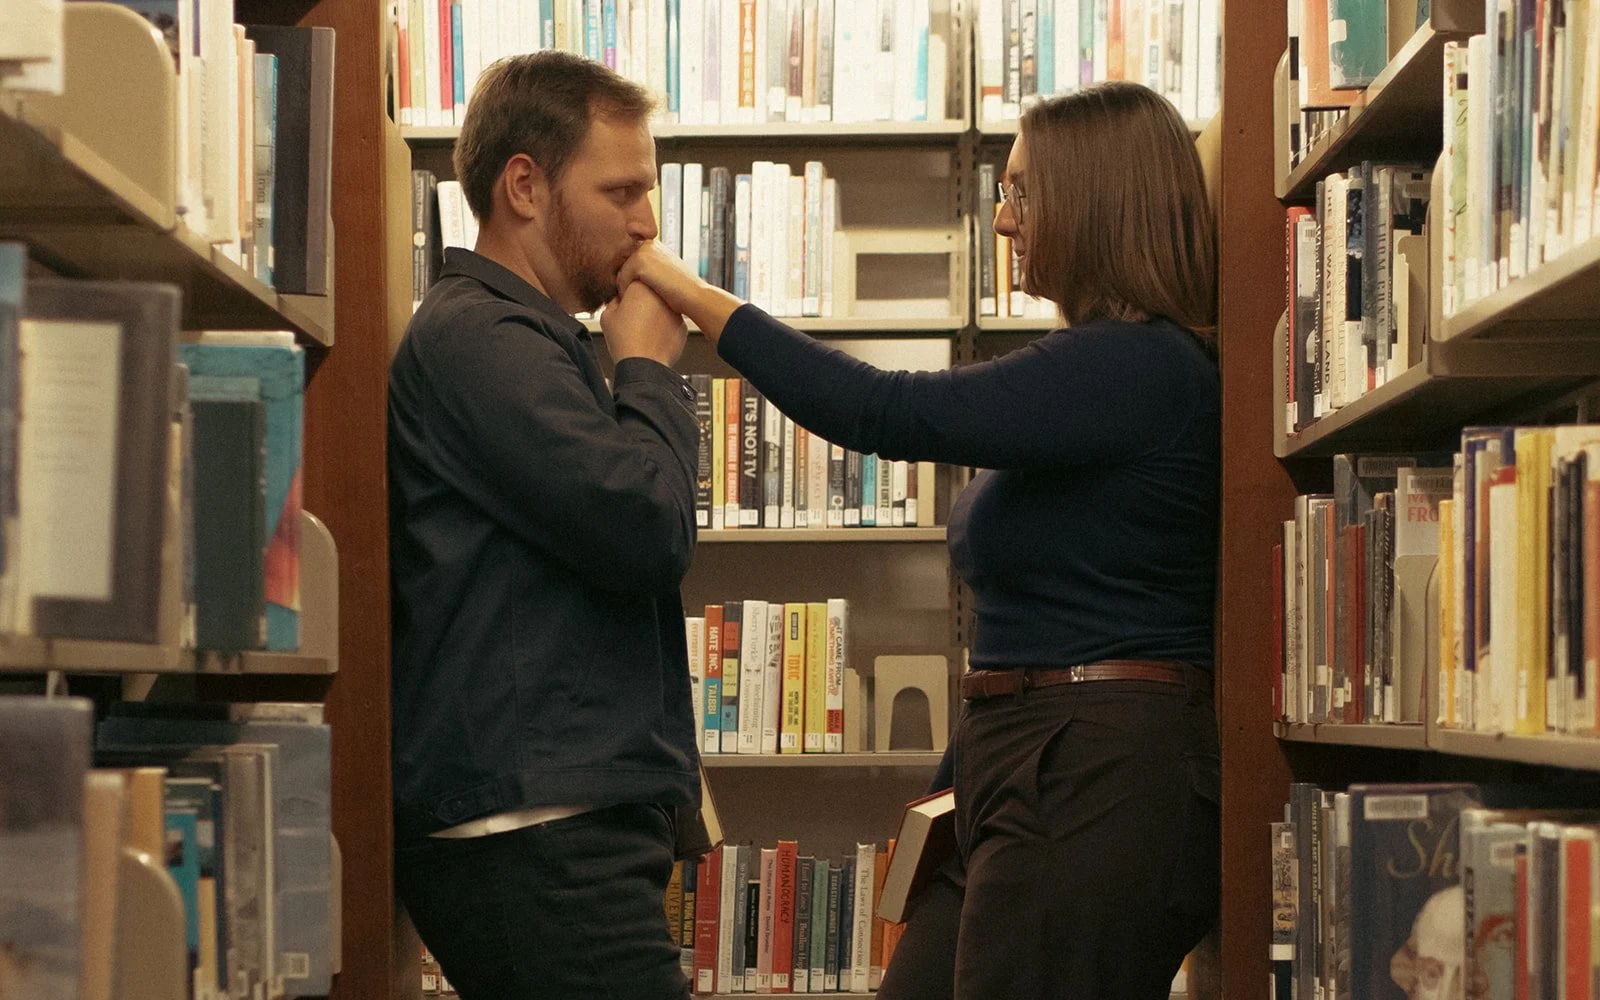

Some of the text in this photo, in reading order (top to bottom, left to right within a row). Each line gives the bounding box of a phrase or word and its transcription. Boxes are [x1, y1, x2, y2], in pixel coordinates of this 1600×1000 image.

[744, 397, 758, 478] IT'S NOT TV
[1408, 506, 1439, 522] FRO
[708, 626, 719, 673] HATE INC.
[828, 620, 836, 666] SOMETHING
[788, 654, 800, 680] TOXIC
[708, 684, 717, 715] TAIBBI
[1388, 819, 1457, 880] Sh
[780, 850, 791, 924] HUMANOCRACY
[861, 869, 869, 884] The
[860, 886, 868, 906] Laws
[797, 952, 806, 970] Hop
[856, 920, 866, 967] Connection
